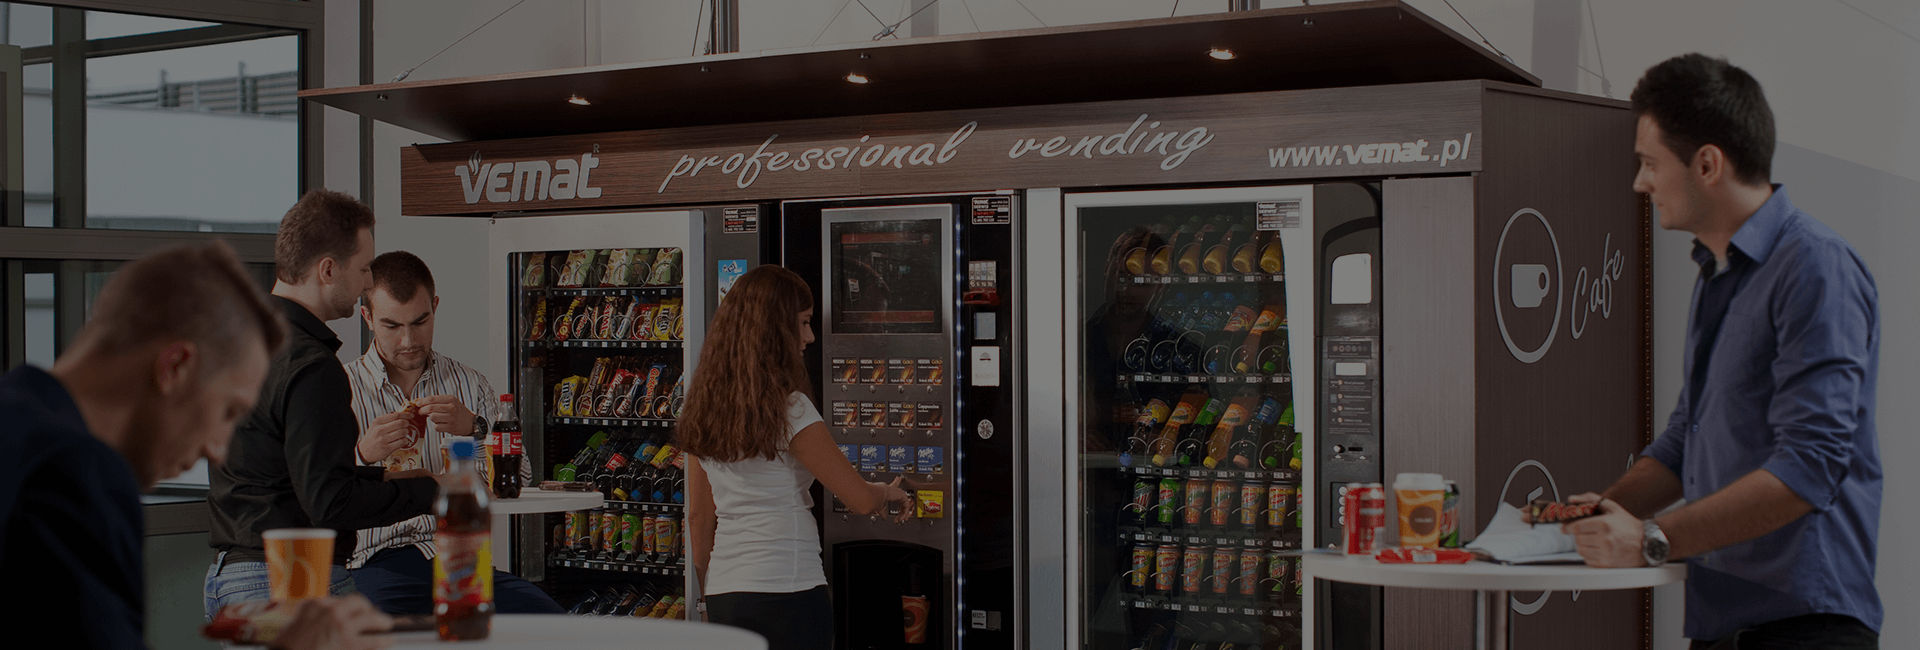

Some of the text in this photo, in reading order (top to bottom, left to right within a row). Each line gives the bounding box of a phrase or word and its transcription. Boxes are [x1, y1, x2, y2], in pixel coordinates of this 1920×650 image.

[657, 112, 1216, 194] professional vending
[1570, 232, 1625, 339] Cafe
